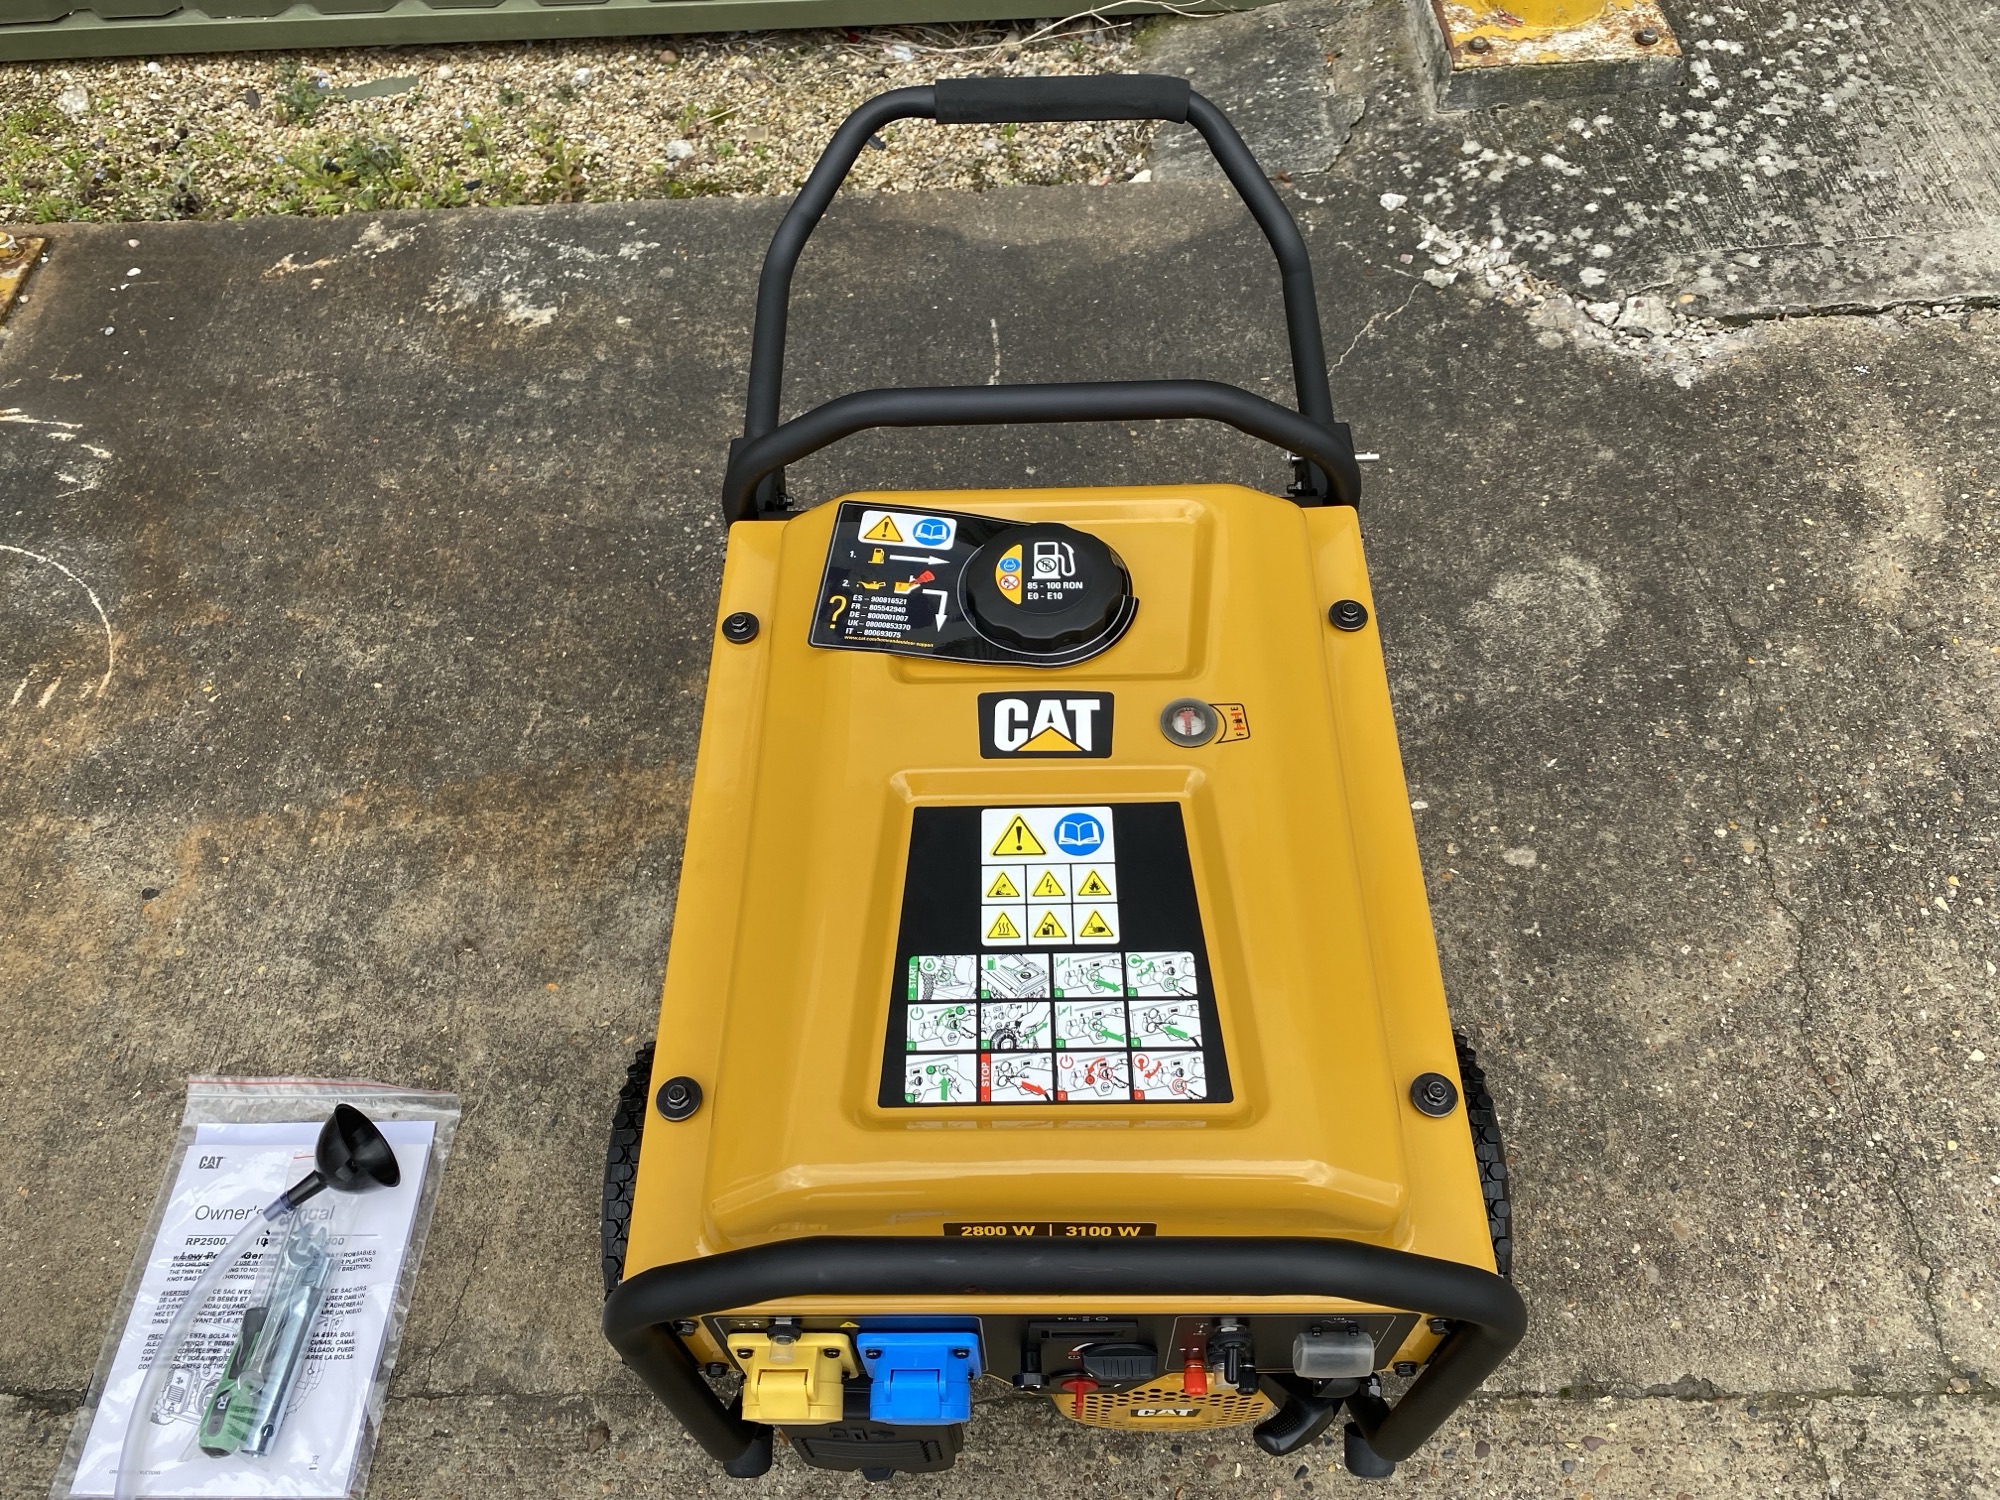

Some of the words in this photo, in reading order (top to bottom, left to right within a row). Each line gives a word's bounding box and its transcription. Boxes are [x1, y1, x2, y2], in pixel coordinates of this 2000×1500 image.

[1063, 581, 1083, 589] RON
[994, 699, 1100, 751] CAT
[199, 1156, 224, 1169] CAT
[961, 1226, 1007, 1236] 2800
[1013, 1226, 1036, 1236] W
[1066, 1226, 1112, 1237] 3100
[1118, 1226, 1141, 1237] W
